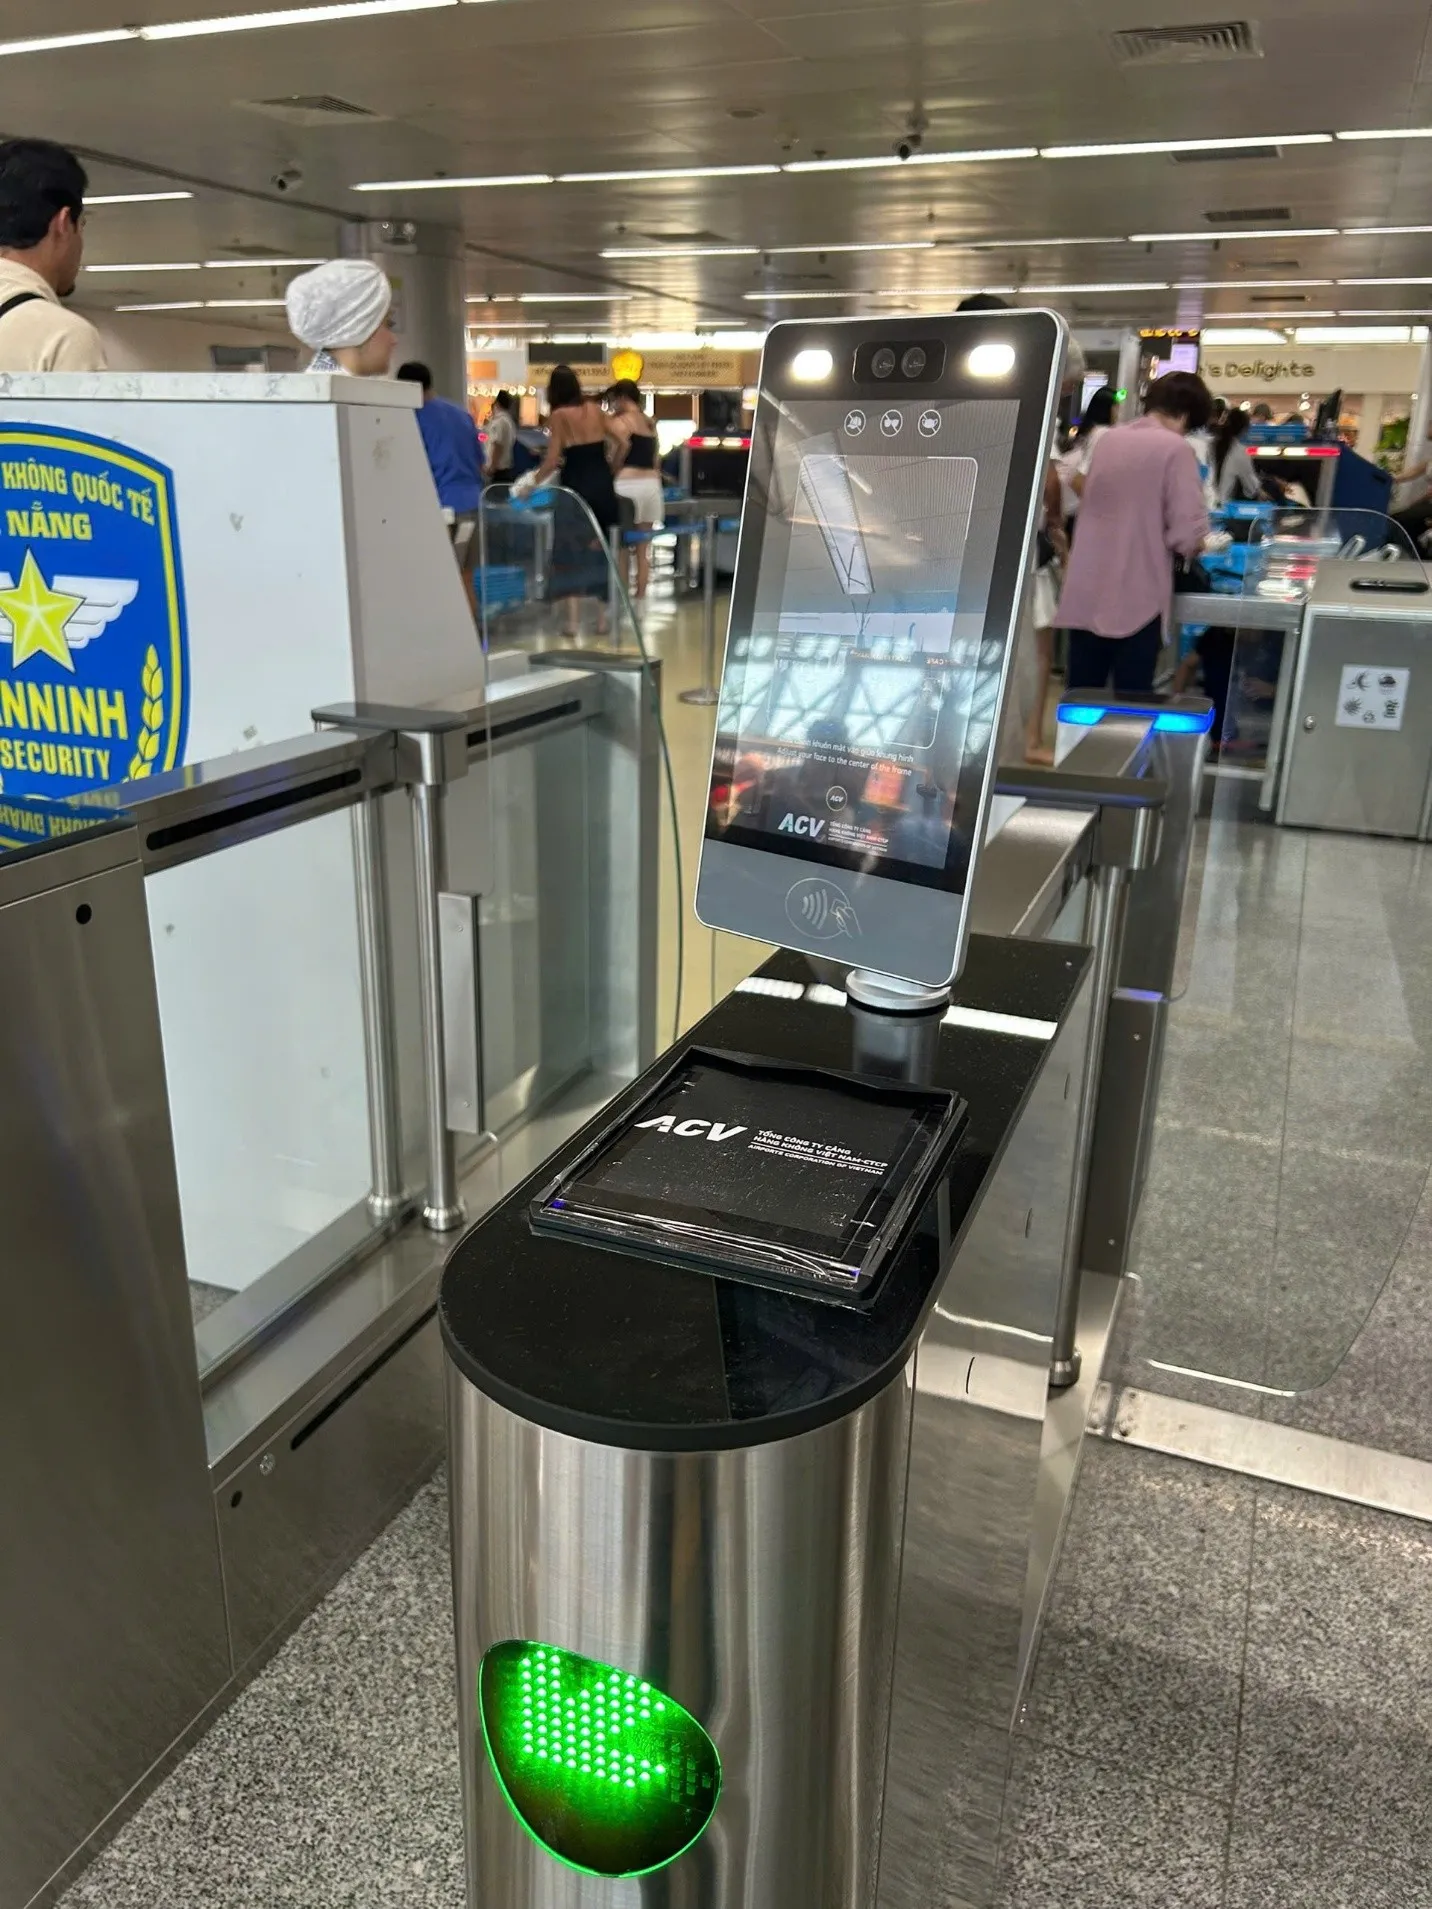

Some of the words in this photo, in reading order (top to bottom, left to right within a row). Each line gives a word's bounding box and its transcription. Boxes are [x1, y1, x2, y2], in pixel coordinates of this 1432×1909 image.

[1225, 359, 1315, 382] Delights
[2, 457, 68, 495] KHÔNG
[71, 470, 124, 511] QUỐC
[127, 487, 155, 526] TẾ
[6, 501, 93, 541] NẴNG
[0, 679, 128, 740] NNINH
[0, 737, 110, 781] SECURITY
[798, 750, 812, 760] your
[813, 752, 827, 762] face
[828, 755, 836, 764] to
[836, 757, 848, 766] the
[848, 759, 870, 769] center
[871, 761, 879, 770] of
[880, 763, 891, 772] the
[891, 766, 912, 777] frame
[777, 812, 825, 837] ACV
[634, 1114, 748, 1142] ACV
[784, 1135, 810, 1146] CÔNG
[780, 1142, 814, 1154] KHÔNG
[815, 1149, 838, 1159] VIỆT
[784, 1152, 836, 1166] CORPORATION
[848, 1165, 883, 1176] VIETNAM
